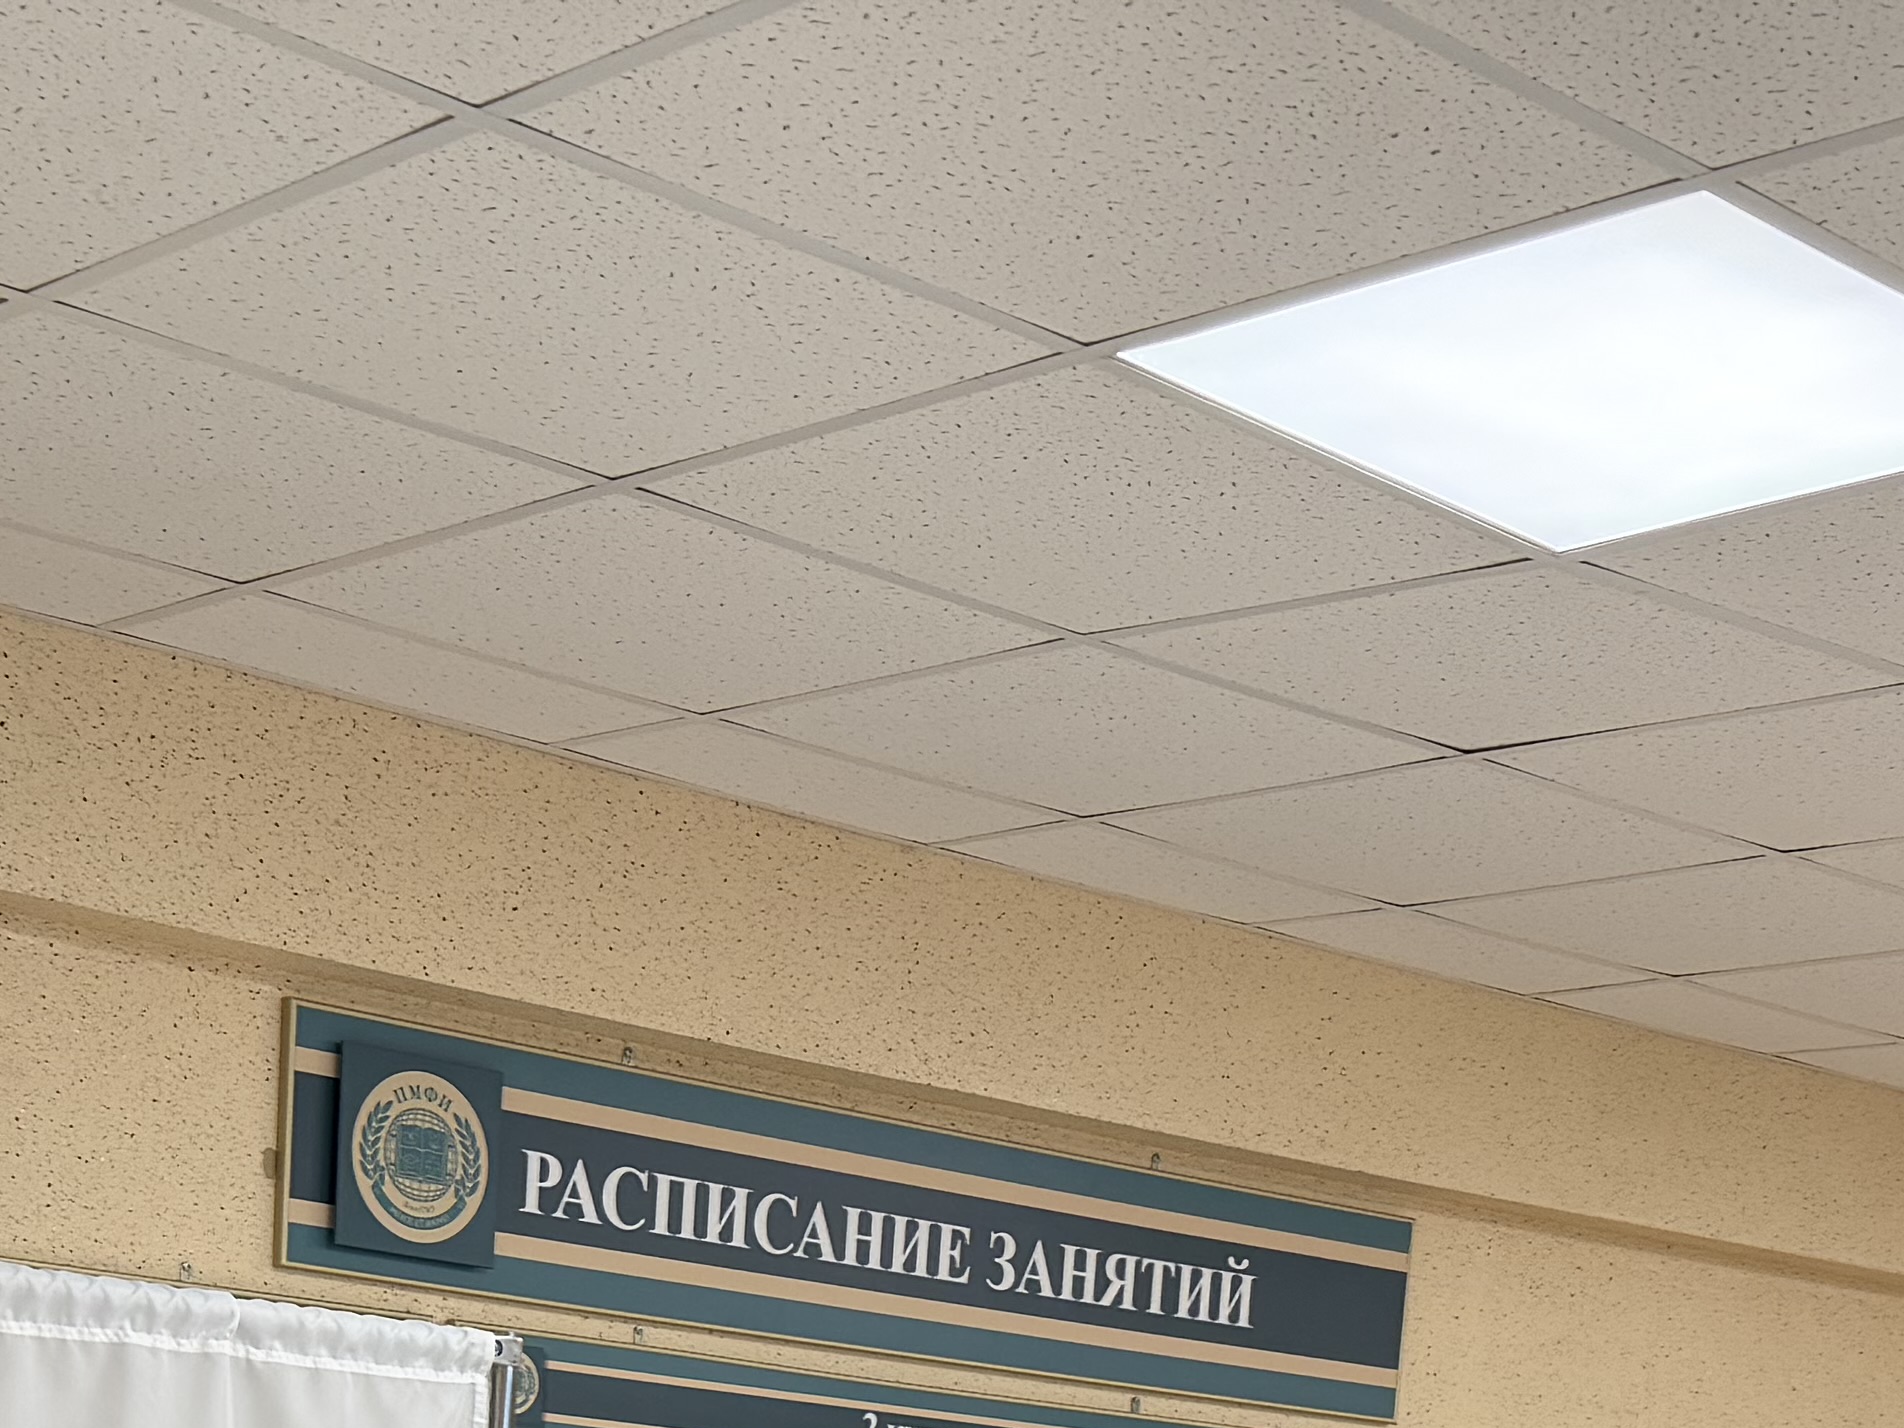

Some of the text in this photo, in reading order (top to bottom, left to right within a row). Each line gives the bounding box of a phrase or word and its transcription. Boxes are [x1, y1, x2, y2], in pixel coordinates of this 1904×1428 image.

[393, 1084, 453, 1113] ПМФИ
[518, 1148, 972, 1285] РАСПИСАНИЕ
[986, 1229, 1259, 1330] ЗАНЯТИЙ
